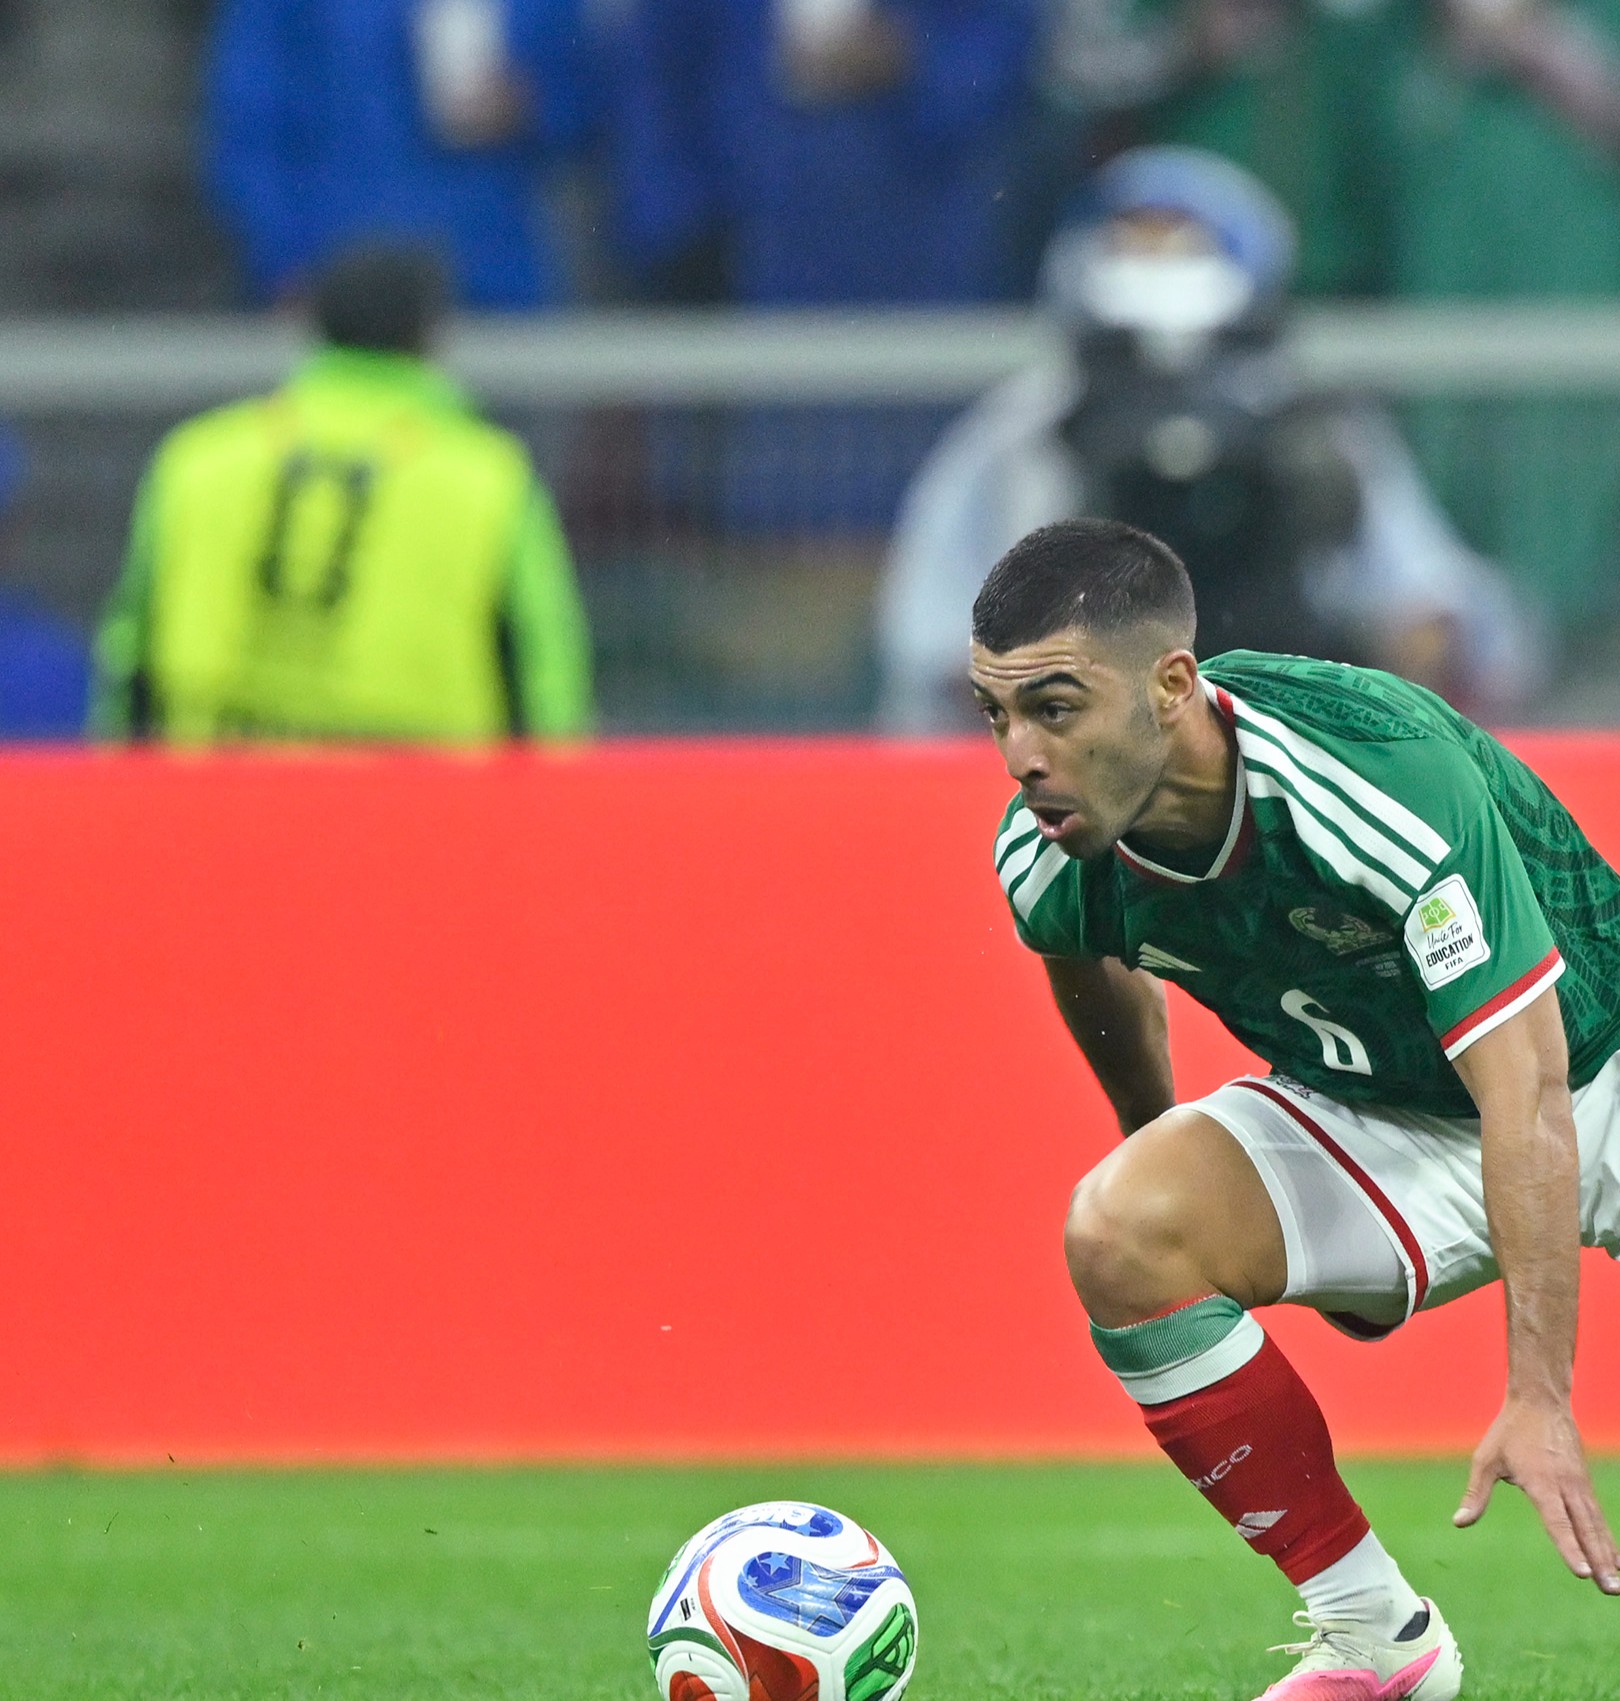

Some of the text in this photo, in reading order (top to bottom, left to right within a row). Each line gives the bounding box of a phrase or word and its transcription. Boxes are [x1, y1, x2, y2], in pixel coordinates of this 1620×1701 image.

[1448, 921, 1463, 938] For
[1425, 933, 1474, 968] EDUCATION
[1445, 956, 1463, 970] FIFA
[1280, 989, 1373, 1076] 6
[1190, 1444, 1253, 1489] XICO
